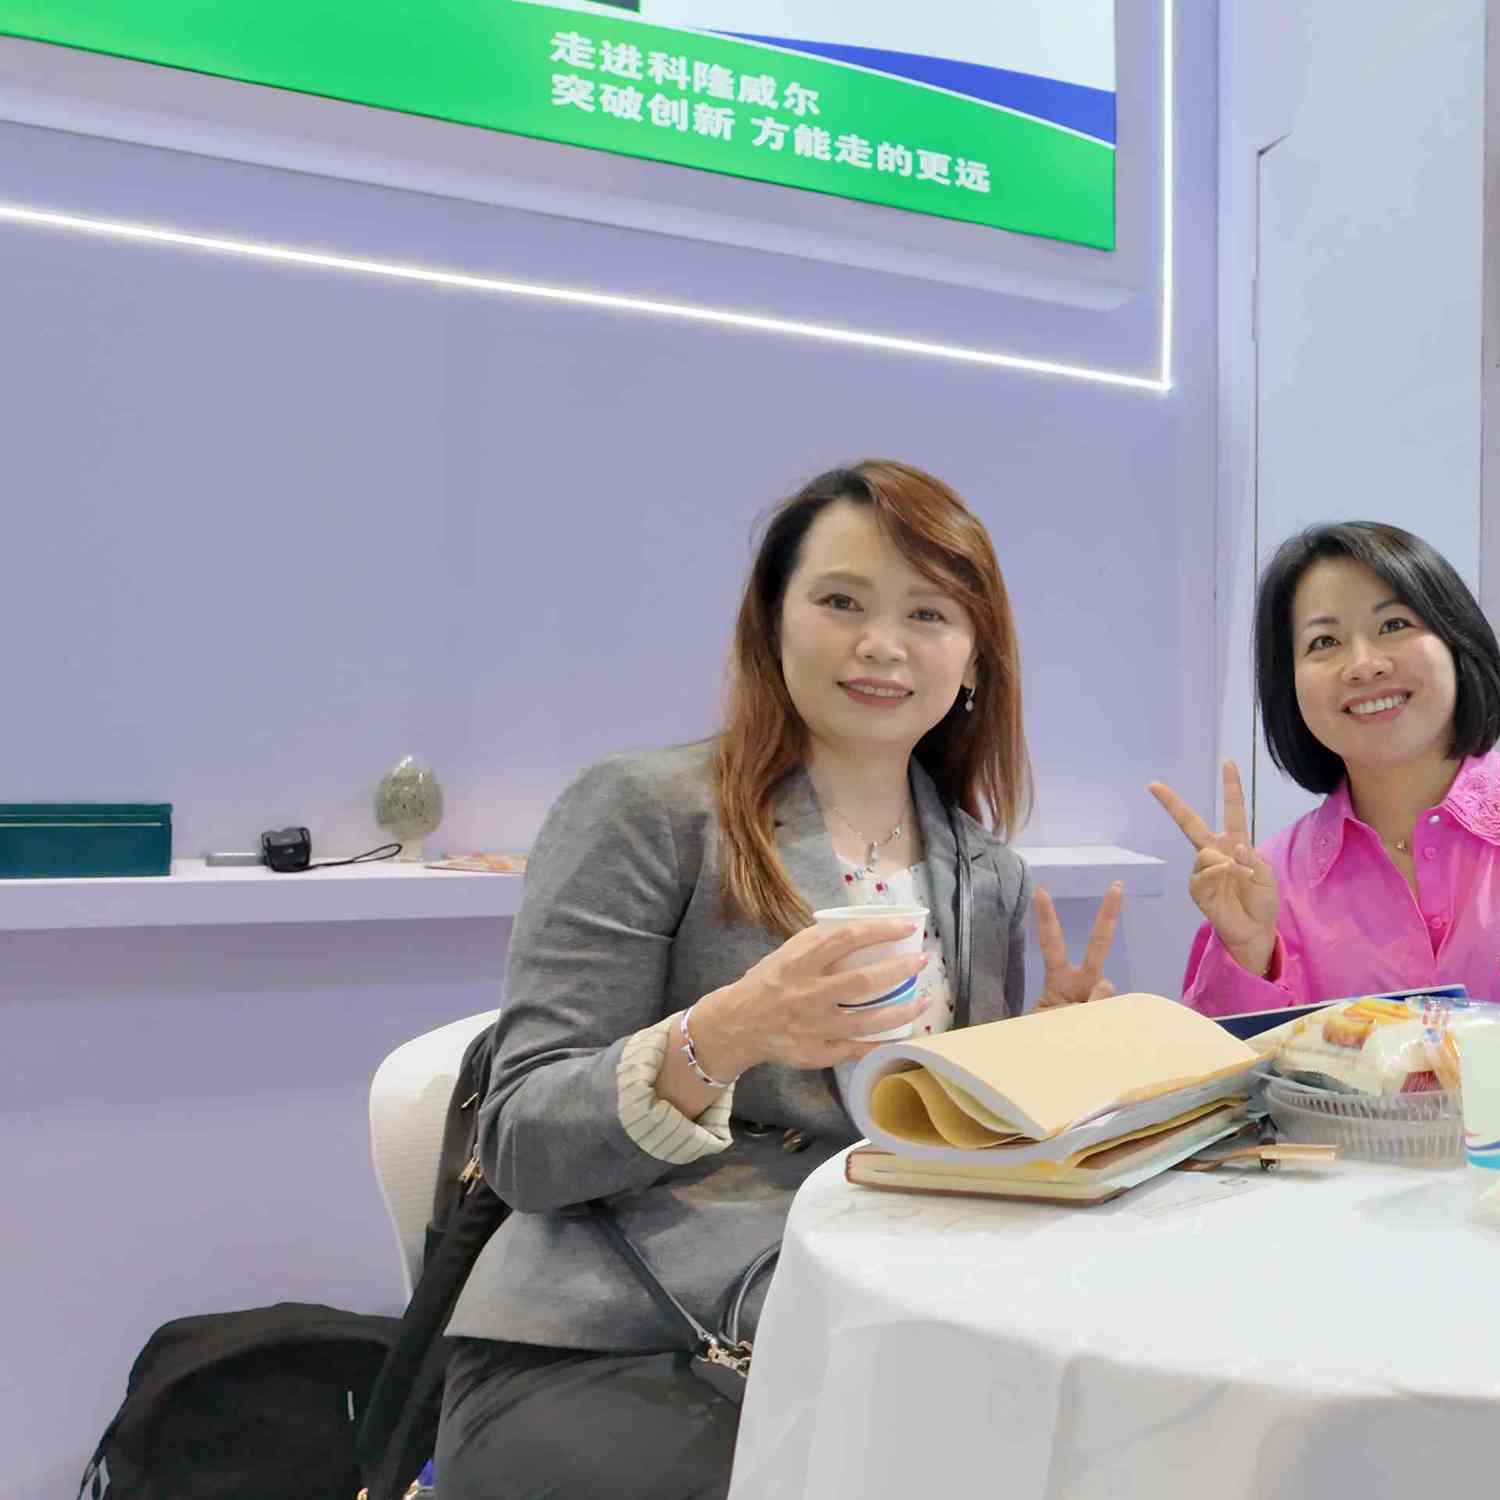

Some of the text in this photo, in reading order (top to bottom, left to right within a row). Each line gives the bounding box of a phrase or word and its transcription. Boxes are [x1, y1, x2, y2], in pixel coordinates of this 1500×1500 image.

[549, 31, 821, 116] 走进科隆威尔
[551, 73, 991, 193] 突破创新 方能走的更远
